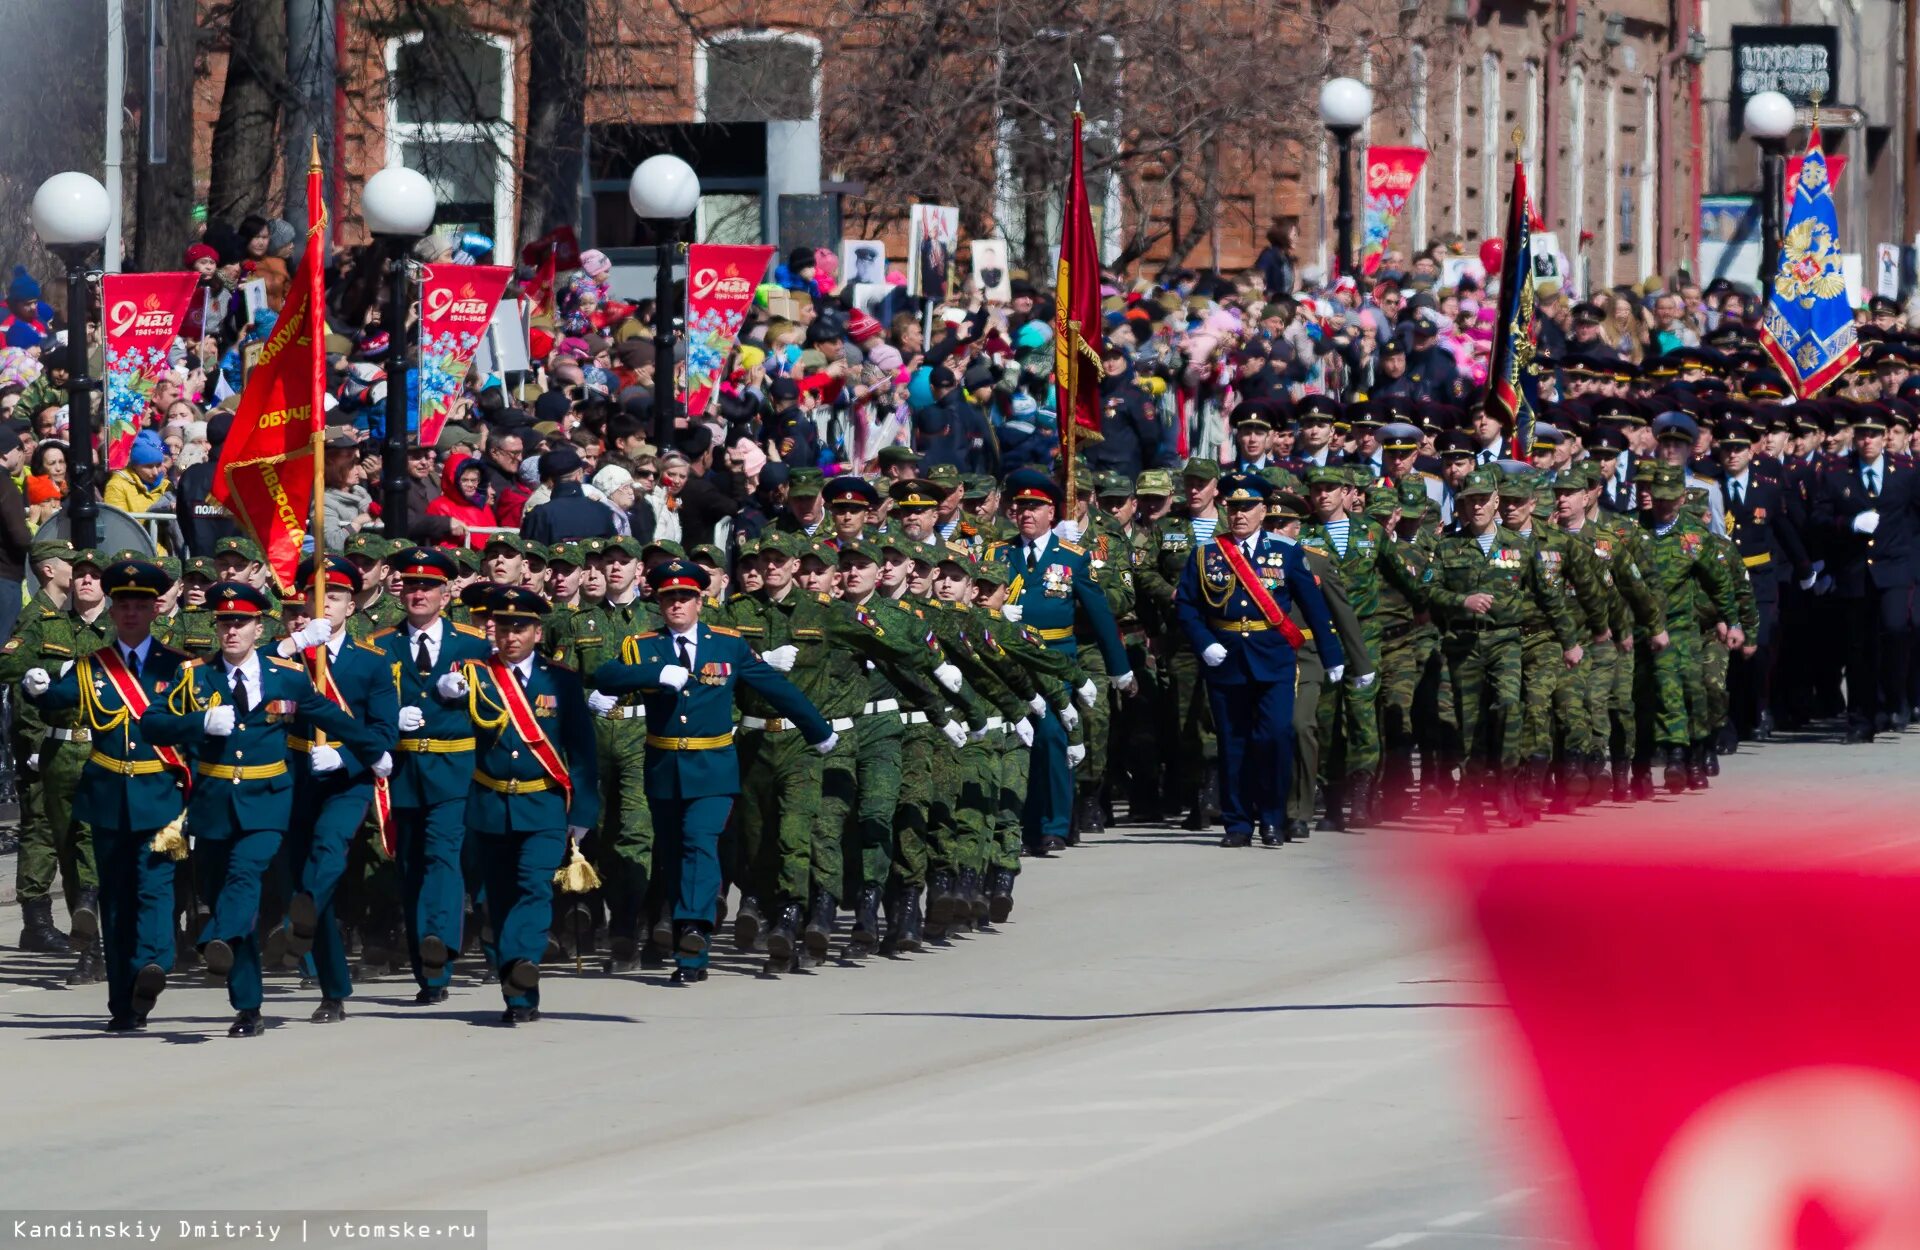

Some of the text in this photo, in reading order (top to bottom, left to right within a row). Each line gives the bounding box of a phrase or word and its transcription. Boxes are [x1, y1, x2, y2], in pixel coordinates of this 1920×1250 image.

[692, 268, 719, 300] 9
[109, 300, 138, 338] 9
[426, 287, 454, 322] 9
[135, 327, 173, 336] 1941-1945
